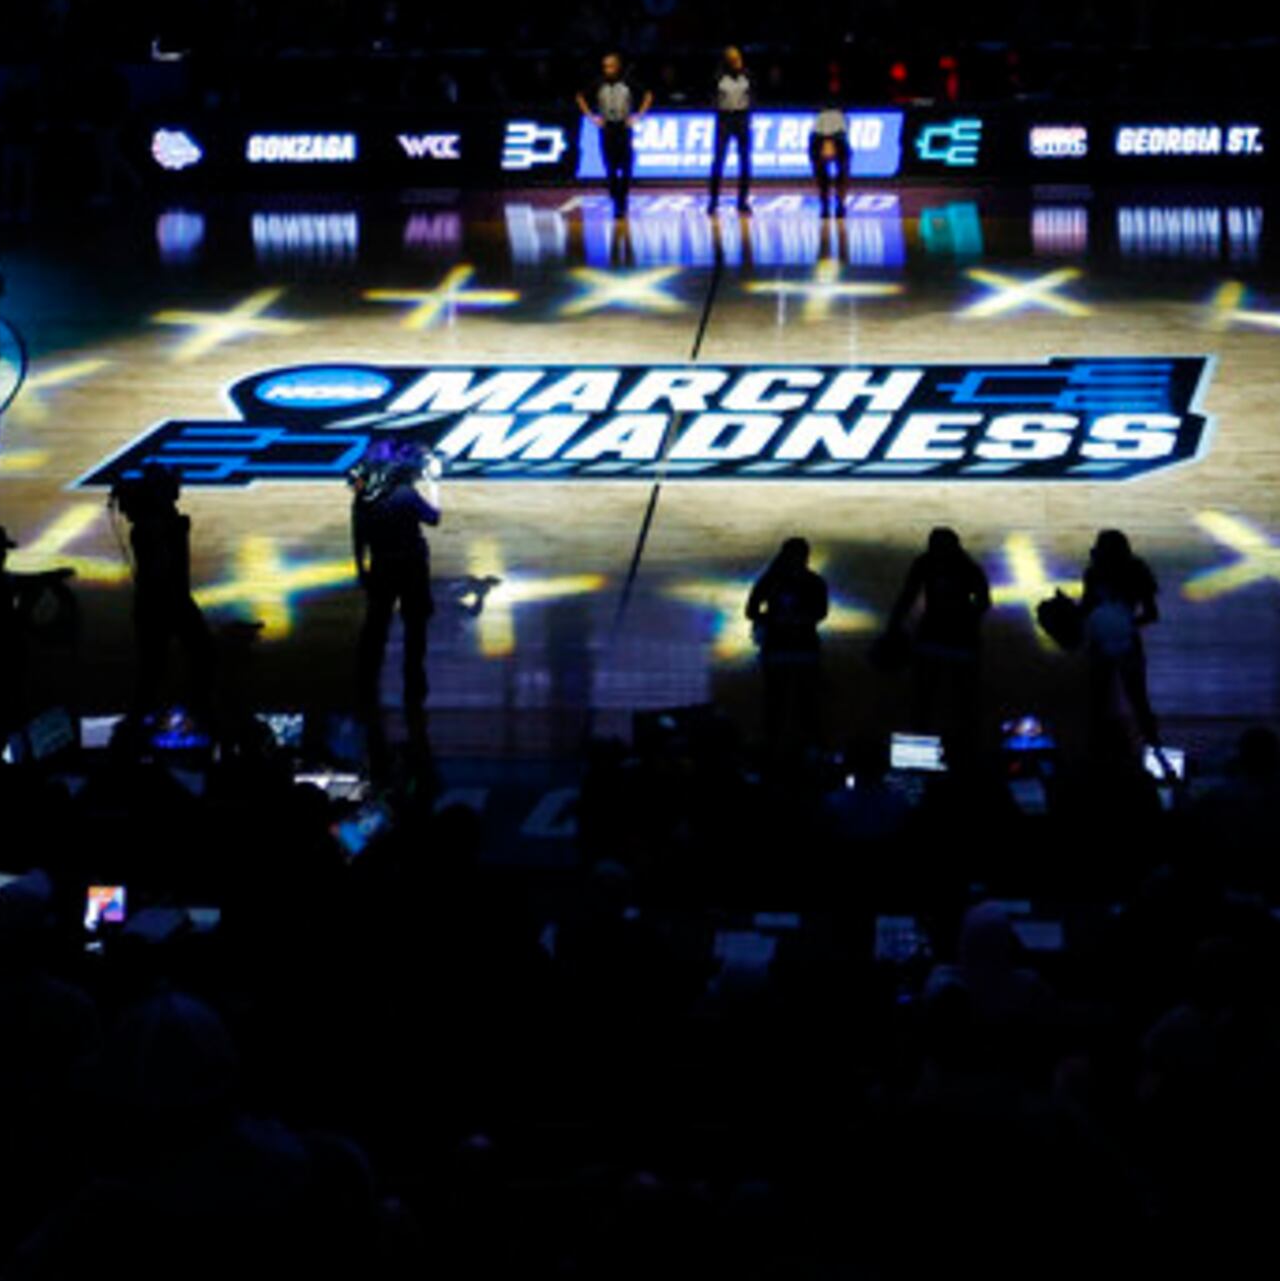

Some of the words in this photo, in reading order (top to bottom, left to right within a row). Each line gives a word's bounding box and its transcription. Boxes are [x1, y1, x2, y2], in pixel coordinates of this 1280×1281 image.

[247, 133, 356, 162] GONZAGA
[1115, 126, 1222, 155] GEORGIA
[1225, 126, 1264, 155] ST.
[385, 369, 925, 412] MARCH
[434, 412, 1182, 460] MADNESS
